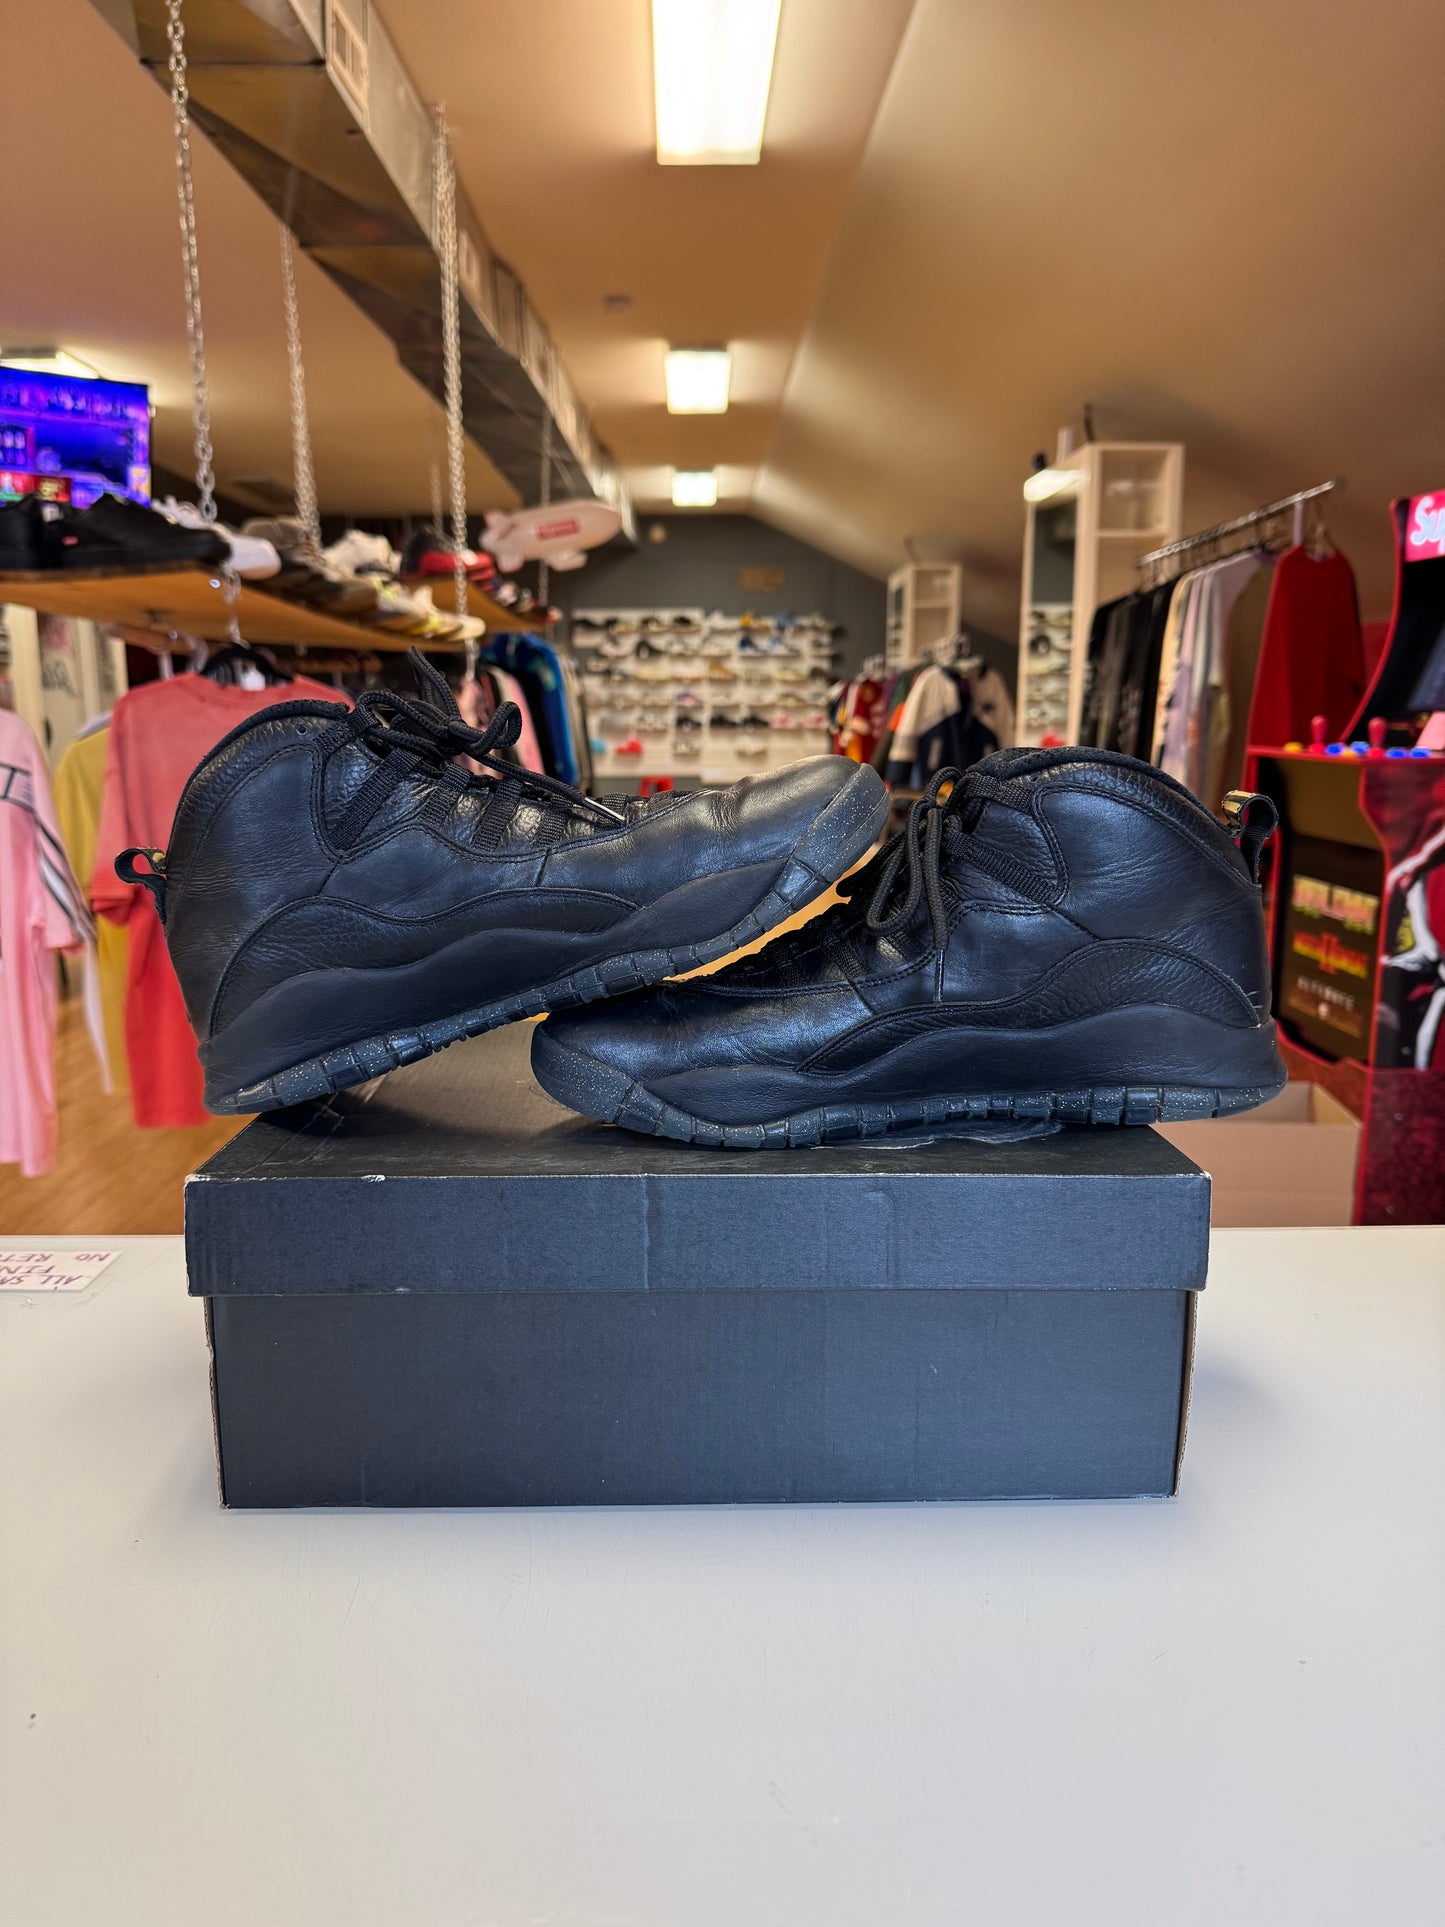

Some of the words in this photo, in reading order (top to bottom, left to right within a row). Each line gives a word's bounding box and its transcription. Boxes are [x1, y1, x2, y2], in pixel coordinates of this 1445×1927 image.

[0, 1253, 54, 1262] RET
[74, 1253, 111, 1262] NO
[39, 1274, 83, 1285] ALL
